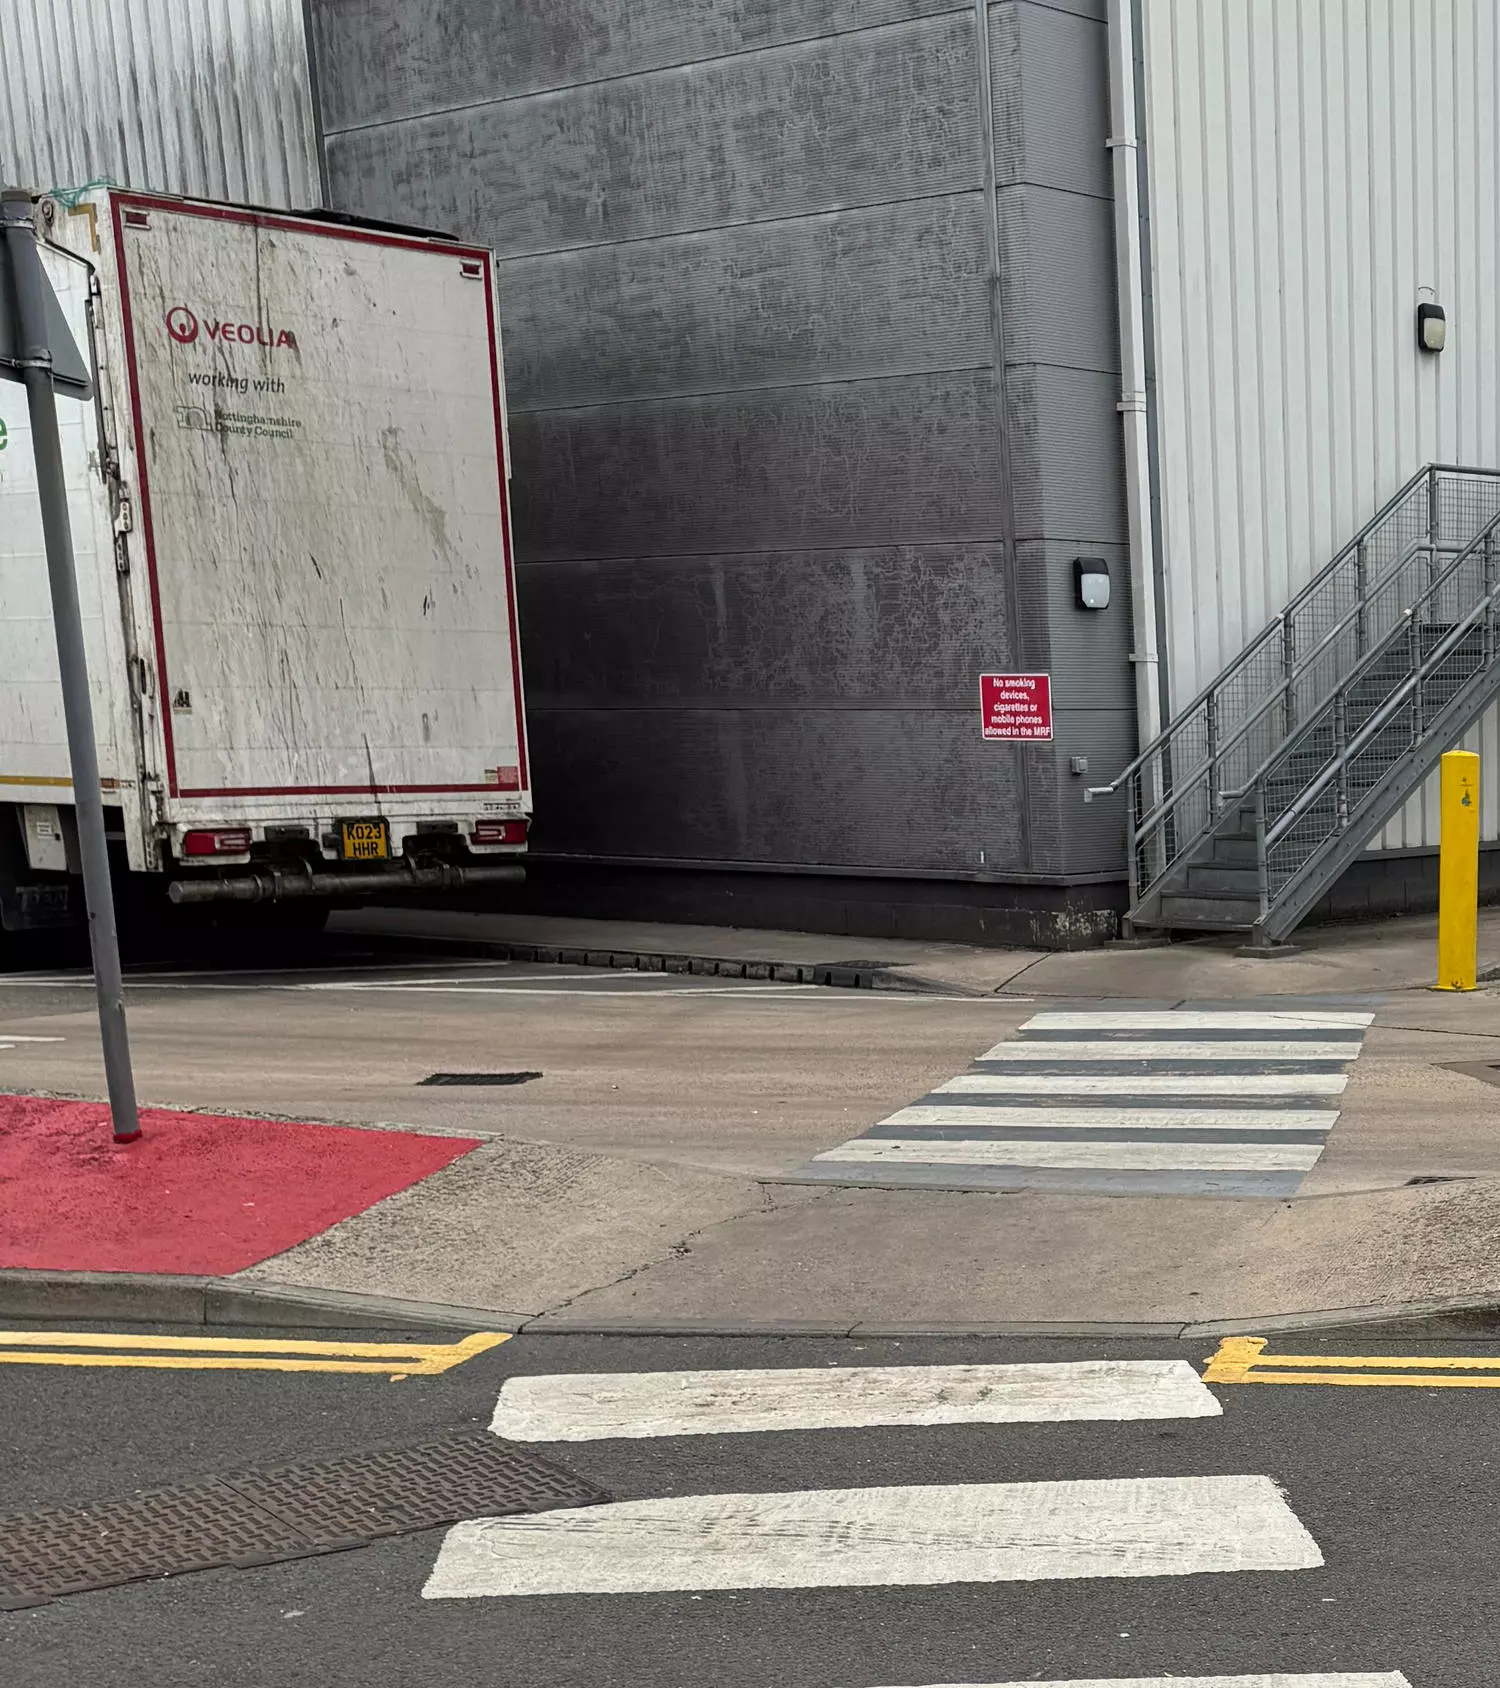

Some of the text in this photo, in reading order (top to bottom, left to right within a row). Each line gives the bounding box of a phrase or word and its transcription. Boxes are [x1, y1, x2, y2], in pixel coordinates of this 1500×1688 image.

[203, 319, 296, 349] VEOLIA
[188, 372, 285, 394] working with
[255, 425, 293, 439] Council
[993, 677, 1035, 690] No smoking
[1000, 690, 1030, 701] devices,
[994, 702, 1038, 714] cigarettes or
[991, 714, 1043, 726] mobile phones
[985, 726, 1051, 736] allowed in the MRF
[346, 823, 382, 840] KO23
[352, 842, 379, 857] HHR
